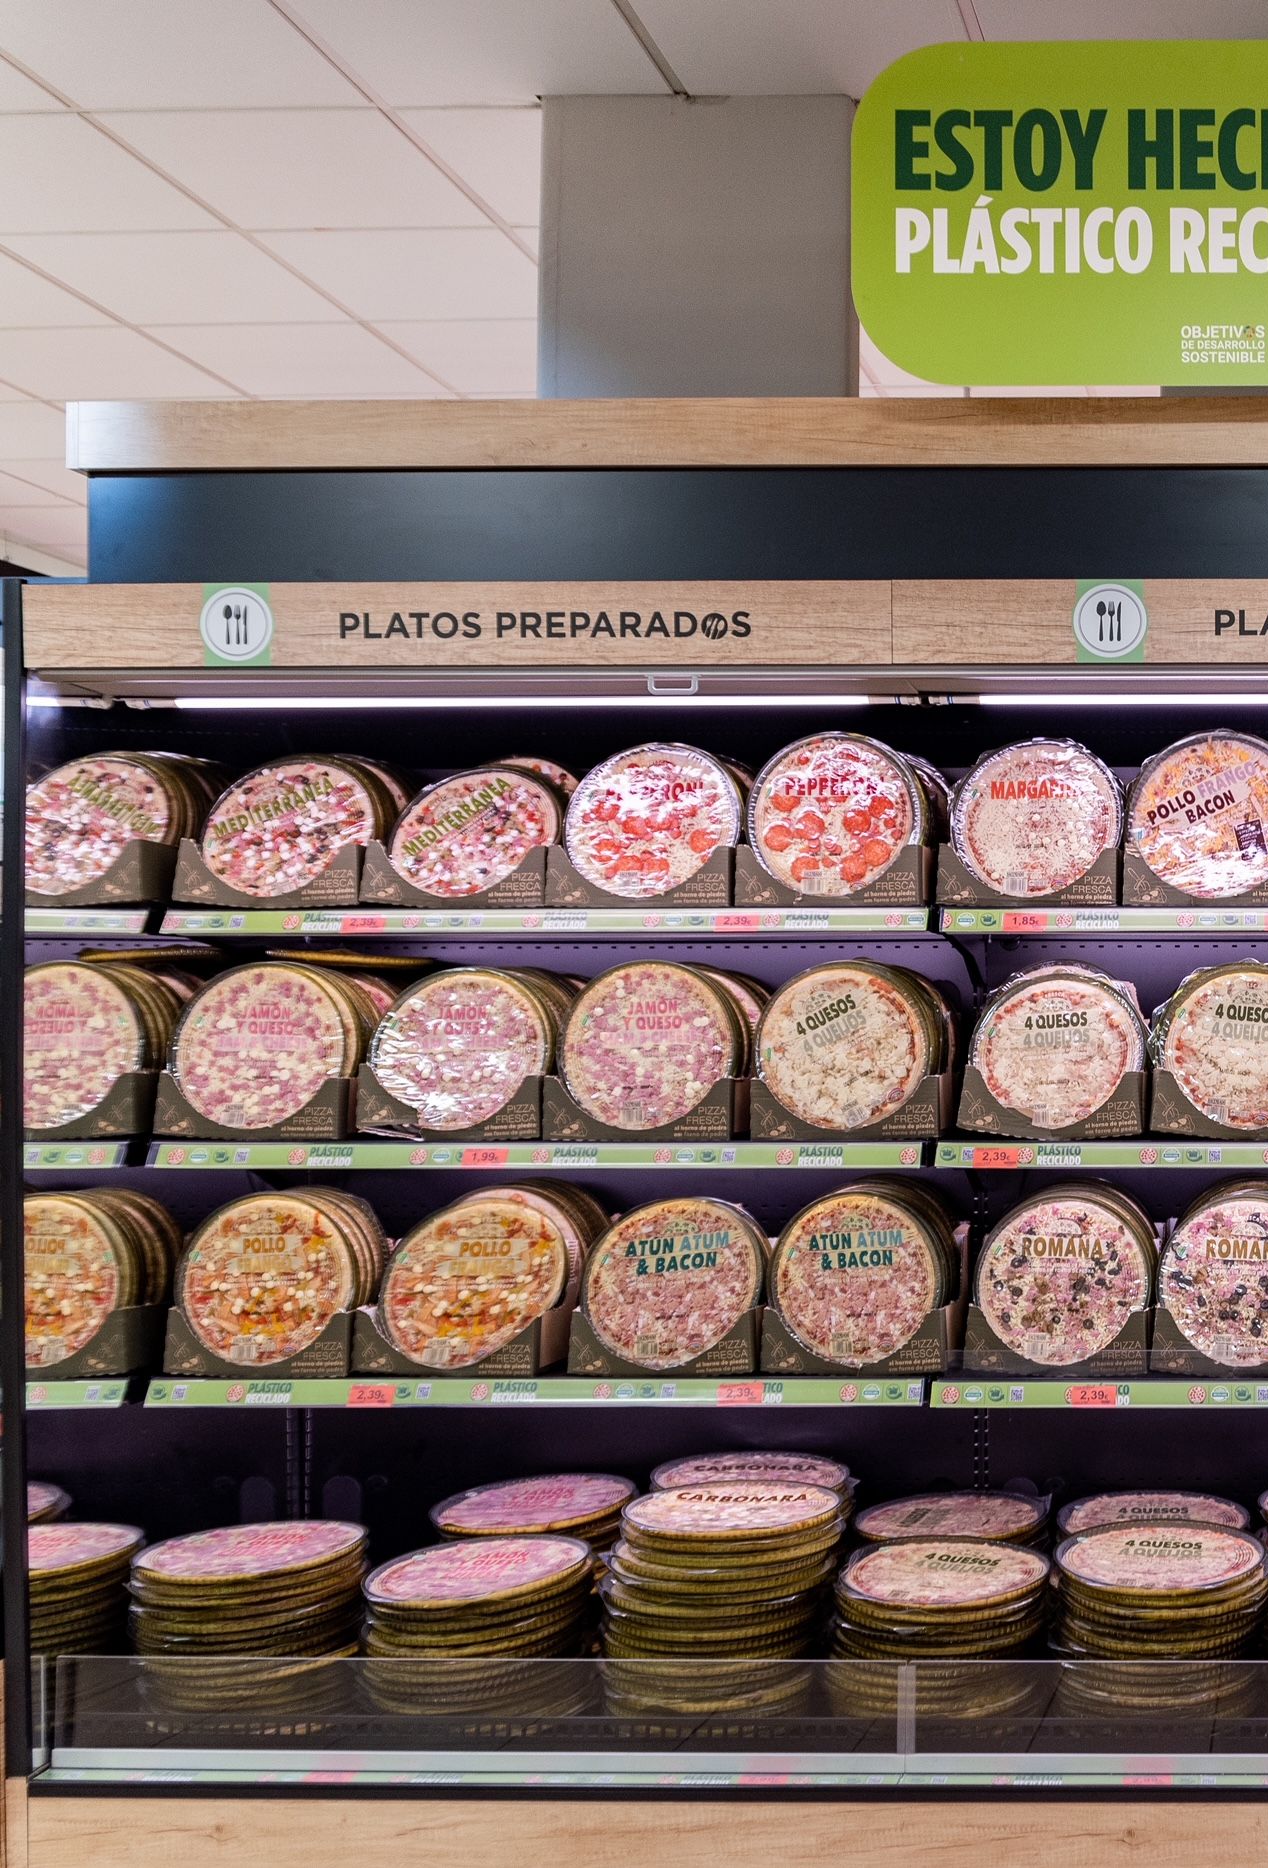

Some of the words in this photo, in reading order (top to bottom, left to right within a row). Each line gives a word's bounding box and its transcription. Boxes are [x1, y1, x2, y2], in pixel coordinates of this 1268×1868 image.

[895, 109, 1107, 190] ESTOY
[895, 195, 1153, 274] PLÁSTICO
[1181, 341, 1195, 349] DE
[1197, 341, 1265, 349] DESARROLLO
[1181, 352, 1265, 363] SOSTENIBLE
[339, 612, 483, 639] PLATOS
[497, 610, 751, 639] PREPARADOS
[1147, 790, 1196, 825] POLLO
[1197, 761, 1256, 797] FRANGO
[215, 777, 336, 839] MEDITERRANEA
[1185, 791, 1236, 824] BACON
[402, 778, 510, 857] MEDITERRANEA
[886, 872, 915, 880] PIZZA
[875, 881, 915, 890] FRESCA
[1076, 911, 1119, 920] PLÁSTICO
[1075, 920, 1119, 929] RECICLADO
[628, 1000, 678, 1015] JAMÓN
[1215, 1005, 1224, 1018] 4
[797, 1021, 805, 1035] 4
[807, 995, 857, 1031] QUESOS
[1025, 1016, 1033, 1030] 4
[1036, 1012, 1088, 1029] QUESOS
[624, 1017, 633, 1029] Y
[636, 1015, 682, 1030] QUESO
[1212, 1022, 1220, 1035] 4
[804, 1038, 813, 1051] 4
[815, 1010, 867, 1048] QUEIJOS
[1023, 1033, 1032, 1047] 4
[1035, 1029, 1090, 1046] QUEIJOS
[698, 1107, 726, 1115] PIZZA
[686, 1116, 726, 1124] FRESCA
[894, 1114, 934, 1122] FRESCA
[310, 1147, 354, 1156] PLÁSTICO
[799, 1147, 843, 1157] PLÁSTICO
[1037, 1146, 1081, 1156] PLÁSTICO
[307, 1156, 351, 1166] RECICLADO
[798, 1157, 842, 1166] RECICLADO
[1037, 1156, 1081, 1165] RECICLADO
[243, 1237, 285, 1253] POLLO
[625, 1239, 675, 1257] ATÚN
[681, 1232, 729, 1250] ATUM
[810, 1232, 852, 1251] ATÚN
[857, 1230, 904, 1247] ATUM
[1022, 1235, 1102, 1258] ROMANA
[459, 1240, 511, 1257] POLLO
[636, 1262, 650, 1276] &
[654, 1253, 717, 1273] BACON
[821, 1255, 834, 1269] &
[838, 1250, 893, 1267] BACON
[911, 1339, 939, 1347] PIZZA
[899, 1349, 940, 1358] FRESCA
[694, 1463, 818, 1472] CARBONARA
[677, 1492, 807, 1502] CARBONARA
[1119, 1506, 1129, 1515] 4
[1132, 1506, 1188, 1515] QUESOS
[1126, 1538, 1136, 1548] 4
[1139, 1538, 1202, 1549] QUESOS
[924, 1553, 935, 1561] 4
[937, 1555, 1000, 1566] QUESOS
